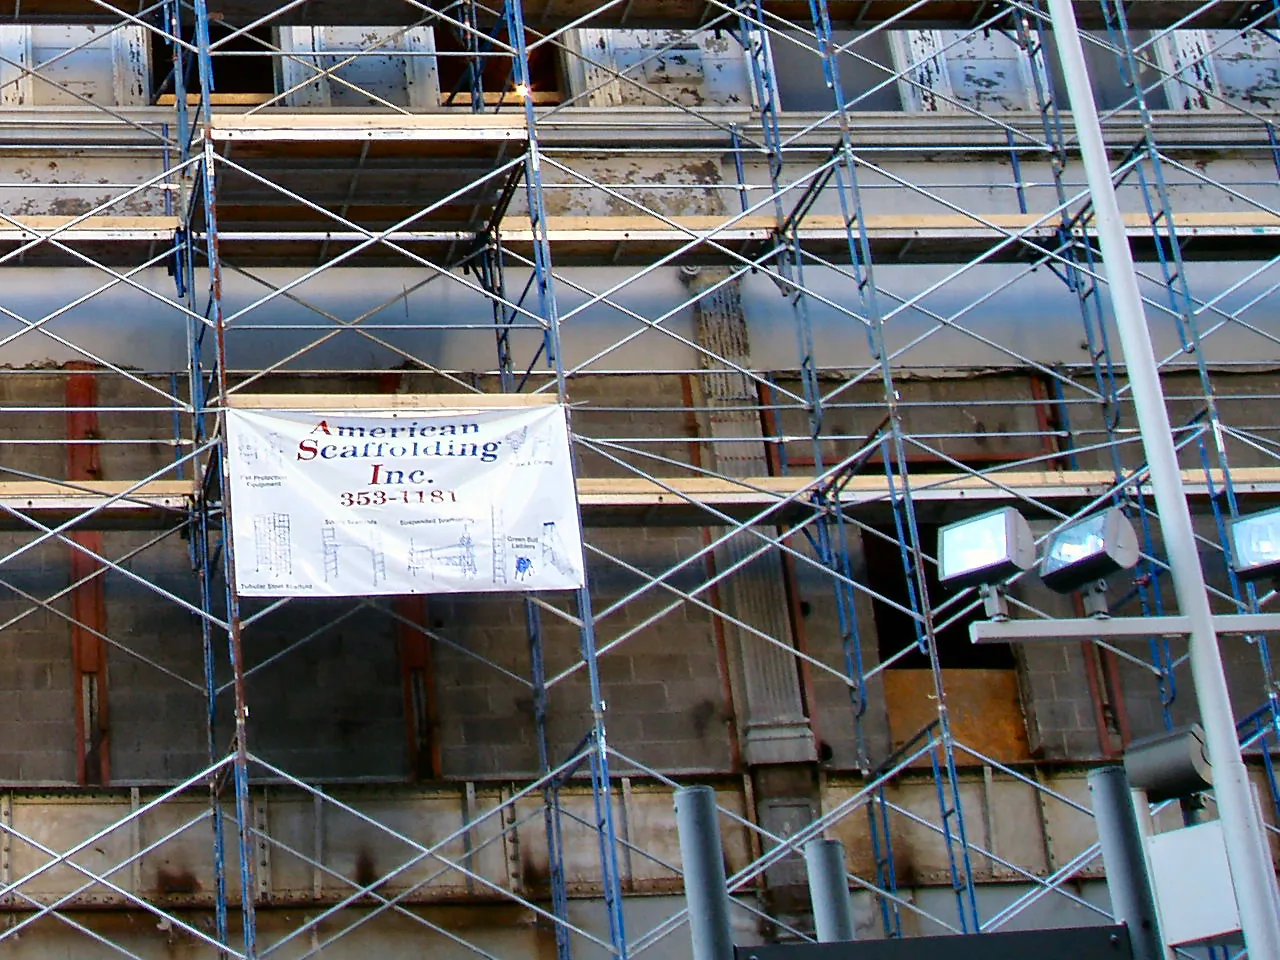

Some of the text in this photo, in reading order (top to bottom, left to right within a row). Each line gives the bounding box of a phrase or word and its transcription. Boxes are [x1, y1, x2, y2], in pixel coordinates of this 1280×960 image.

[310, 420, 479, 438] American
[297, 438, 502, 462] Scaffolding
[368, 463, 434, 486] Inc.
[340, 489, 457, 507] 353-1181
